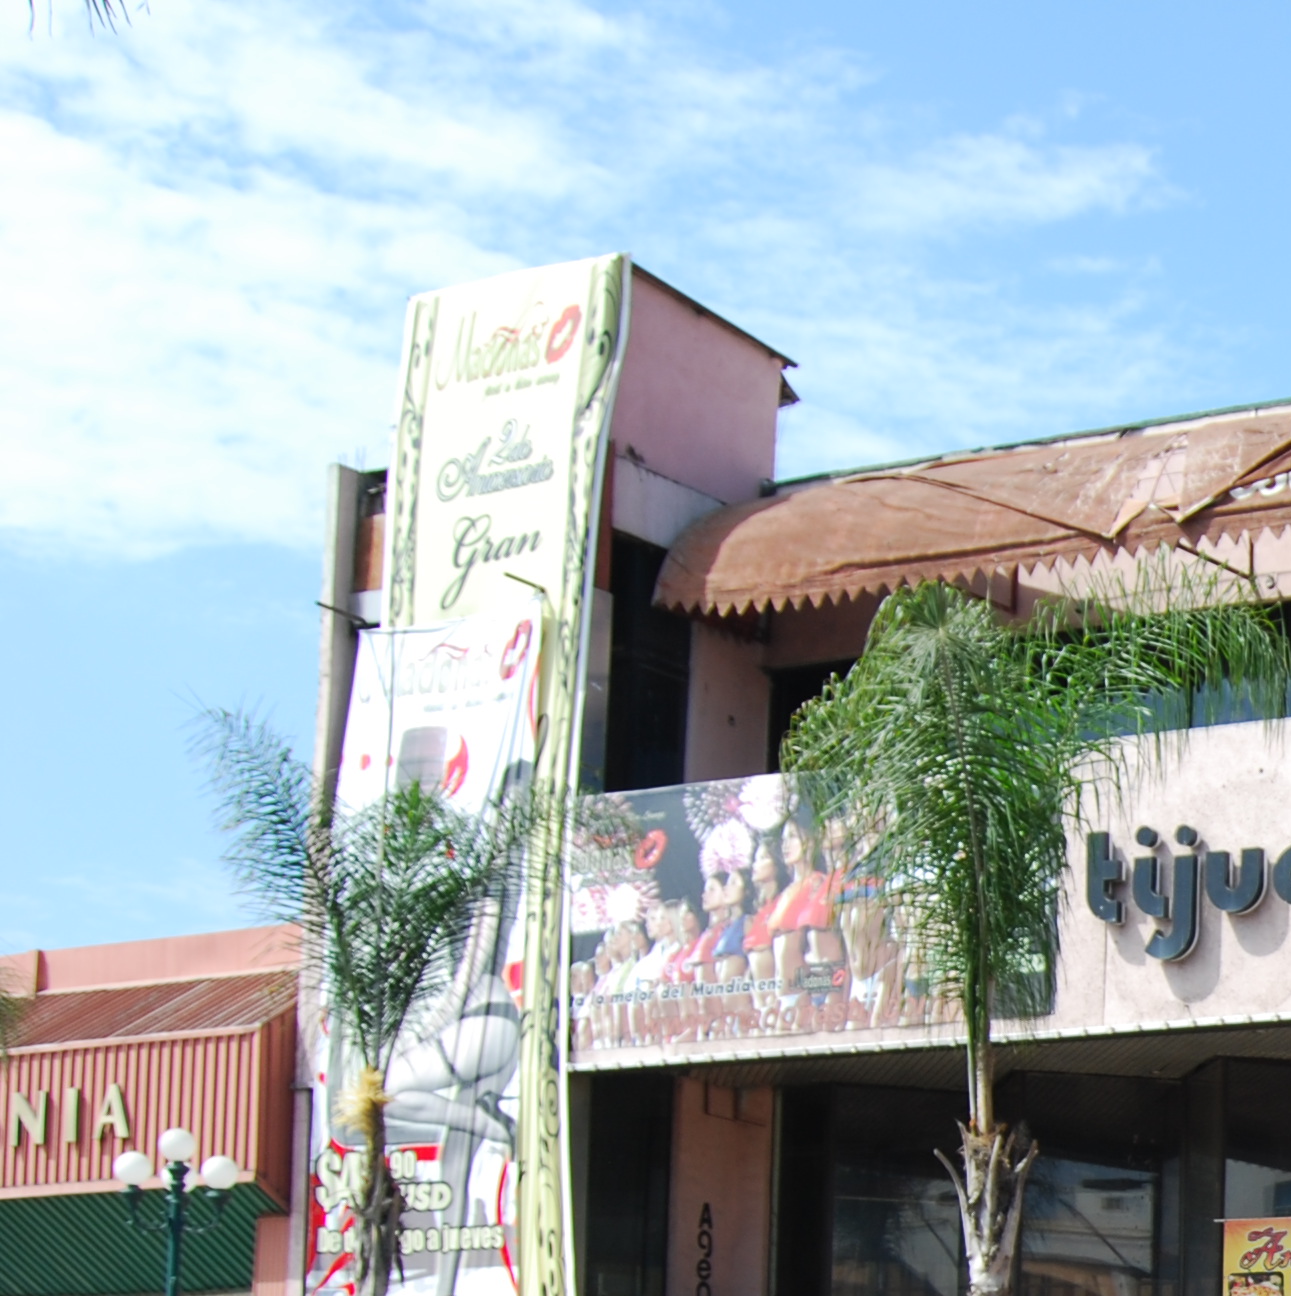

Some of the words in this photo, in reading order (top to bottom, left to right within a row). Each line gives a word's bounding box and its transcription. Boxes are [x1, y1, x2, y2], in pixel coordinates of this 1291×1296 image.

[440, 513, 541, 610] Gran
[610, 988, 654, 1006] mejor
[661, 983, 685, 999] del
[690, 976, 756, 997] Mundial
[10, 1083, 130, 1148] NIA
[442, 1223, 504, 1254] jueves
